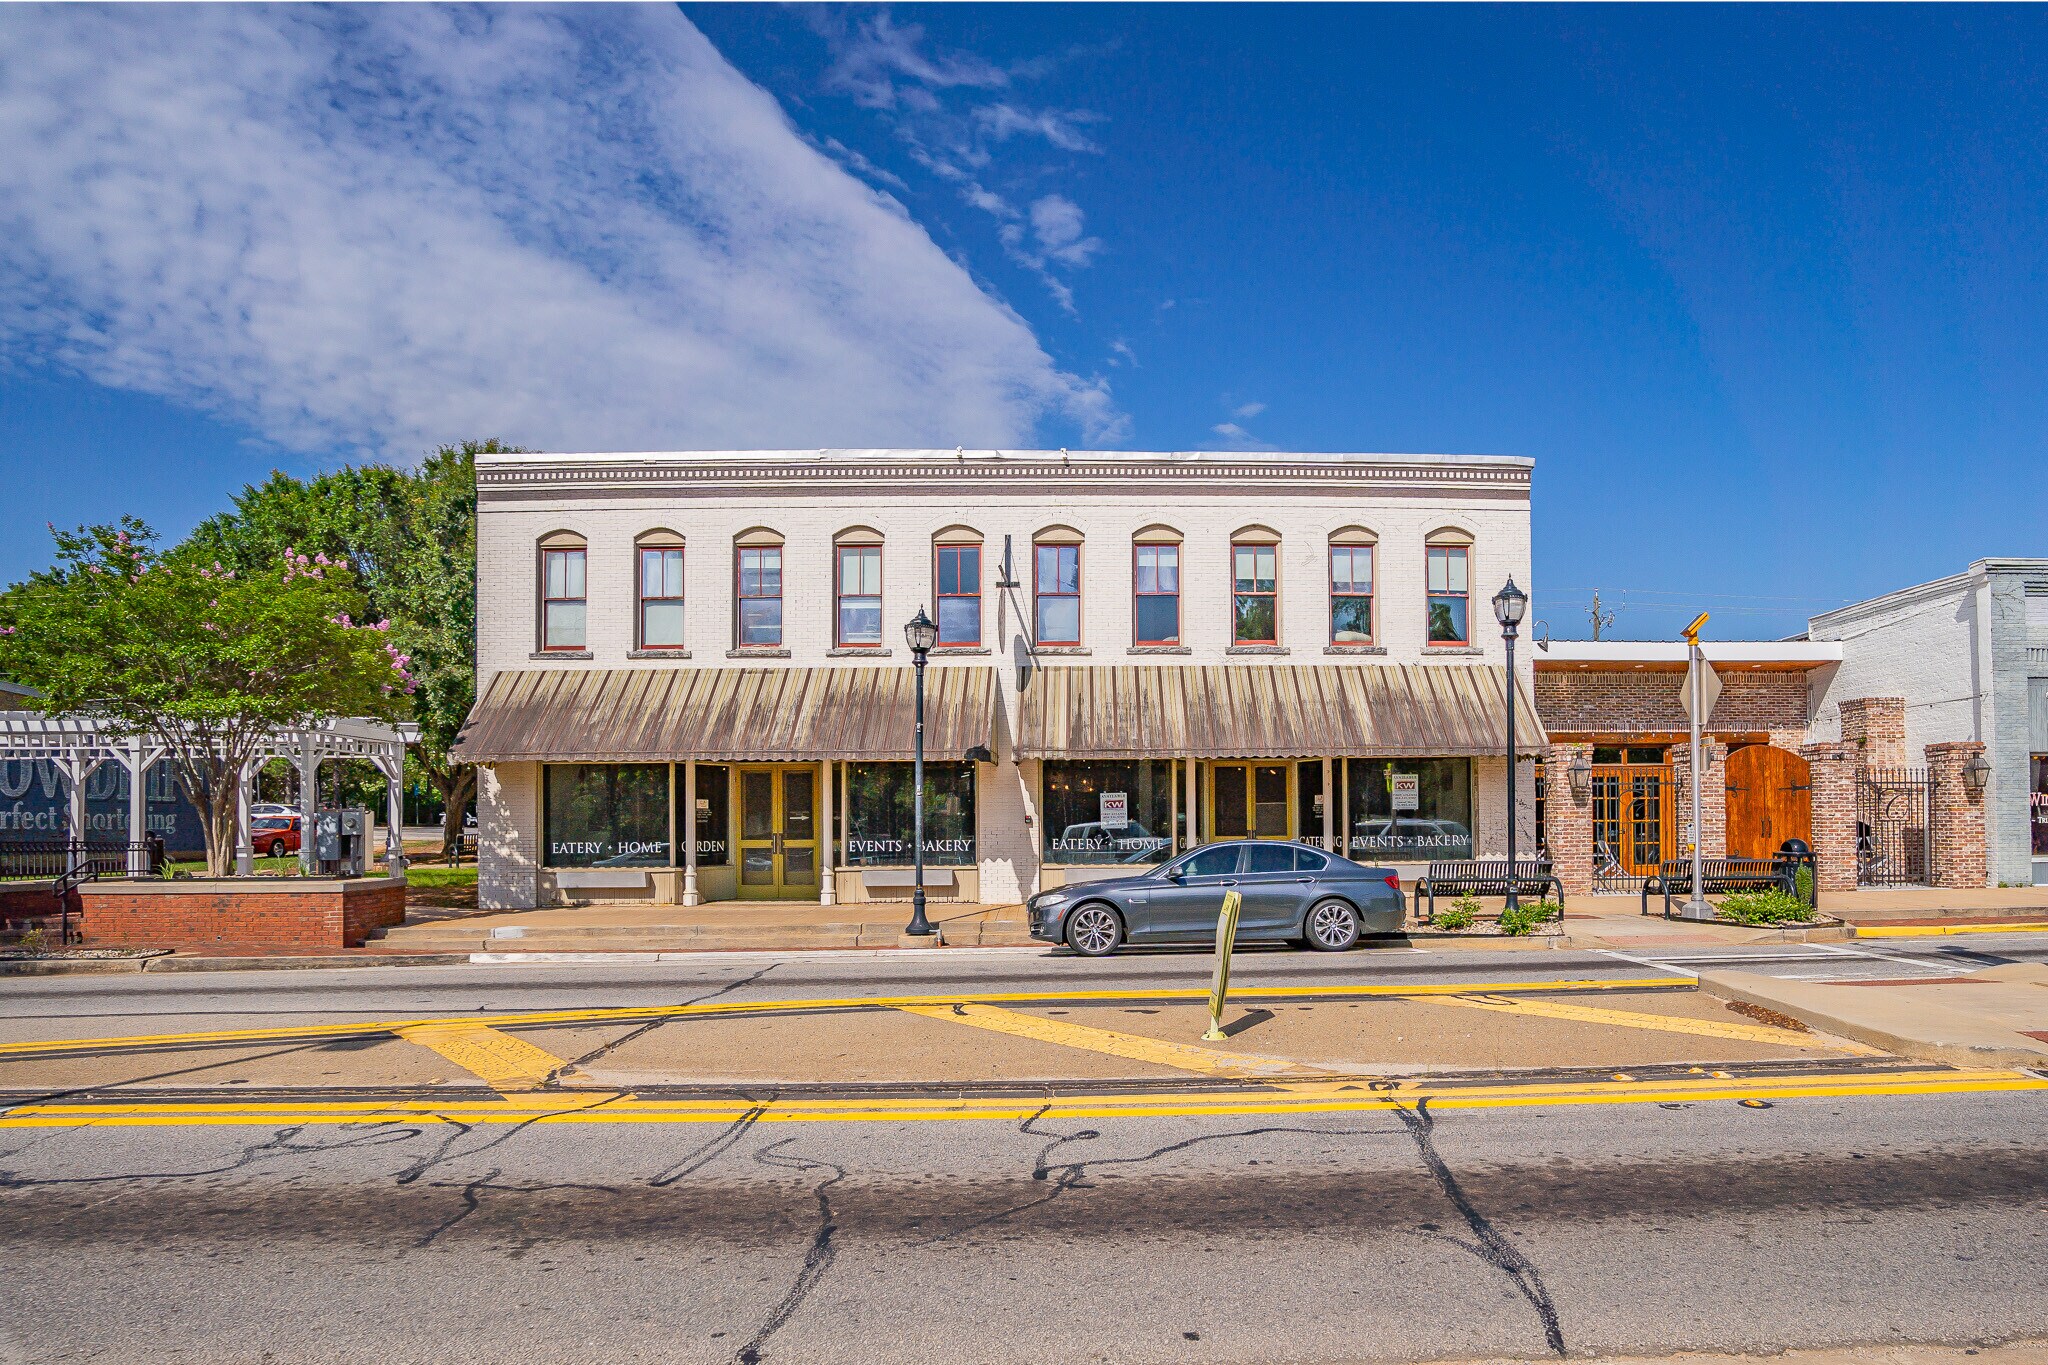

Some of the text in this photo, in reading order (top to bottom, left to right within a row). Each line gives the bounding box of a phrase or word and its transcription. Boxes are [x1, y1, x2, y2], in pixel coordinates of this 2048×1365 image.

[552, 840, 725, 854] EATERY HOME RDEN
[849, 840, 902, 852] EVENTS
[1052, 838, 1164, 850] EATERY HOME
[1300, 836, 1342, 847] CATERG
[1352, 834, 1469, 848] EVENTS BAKERY
